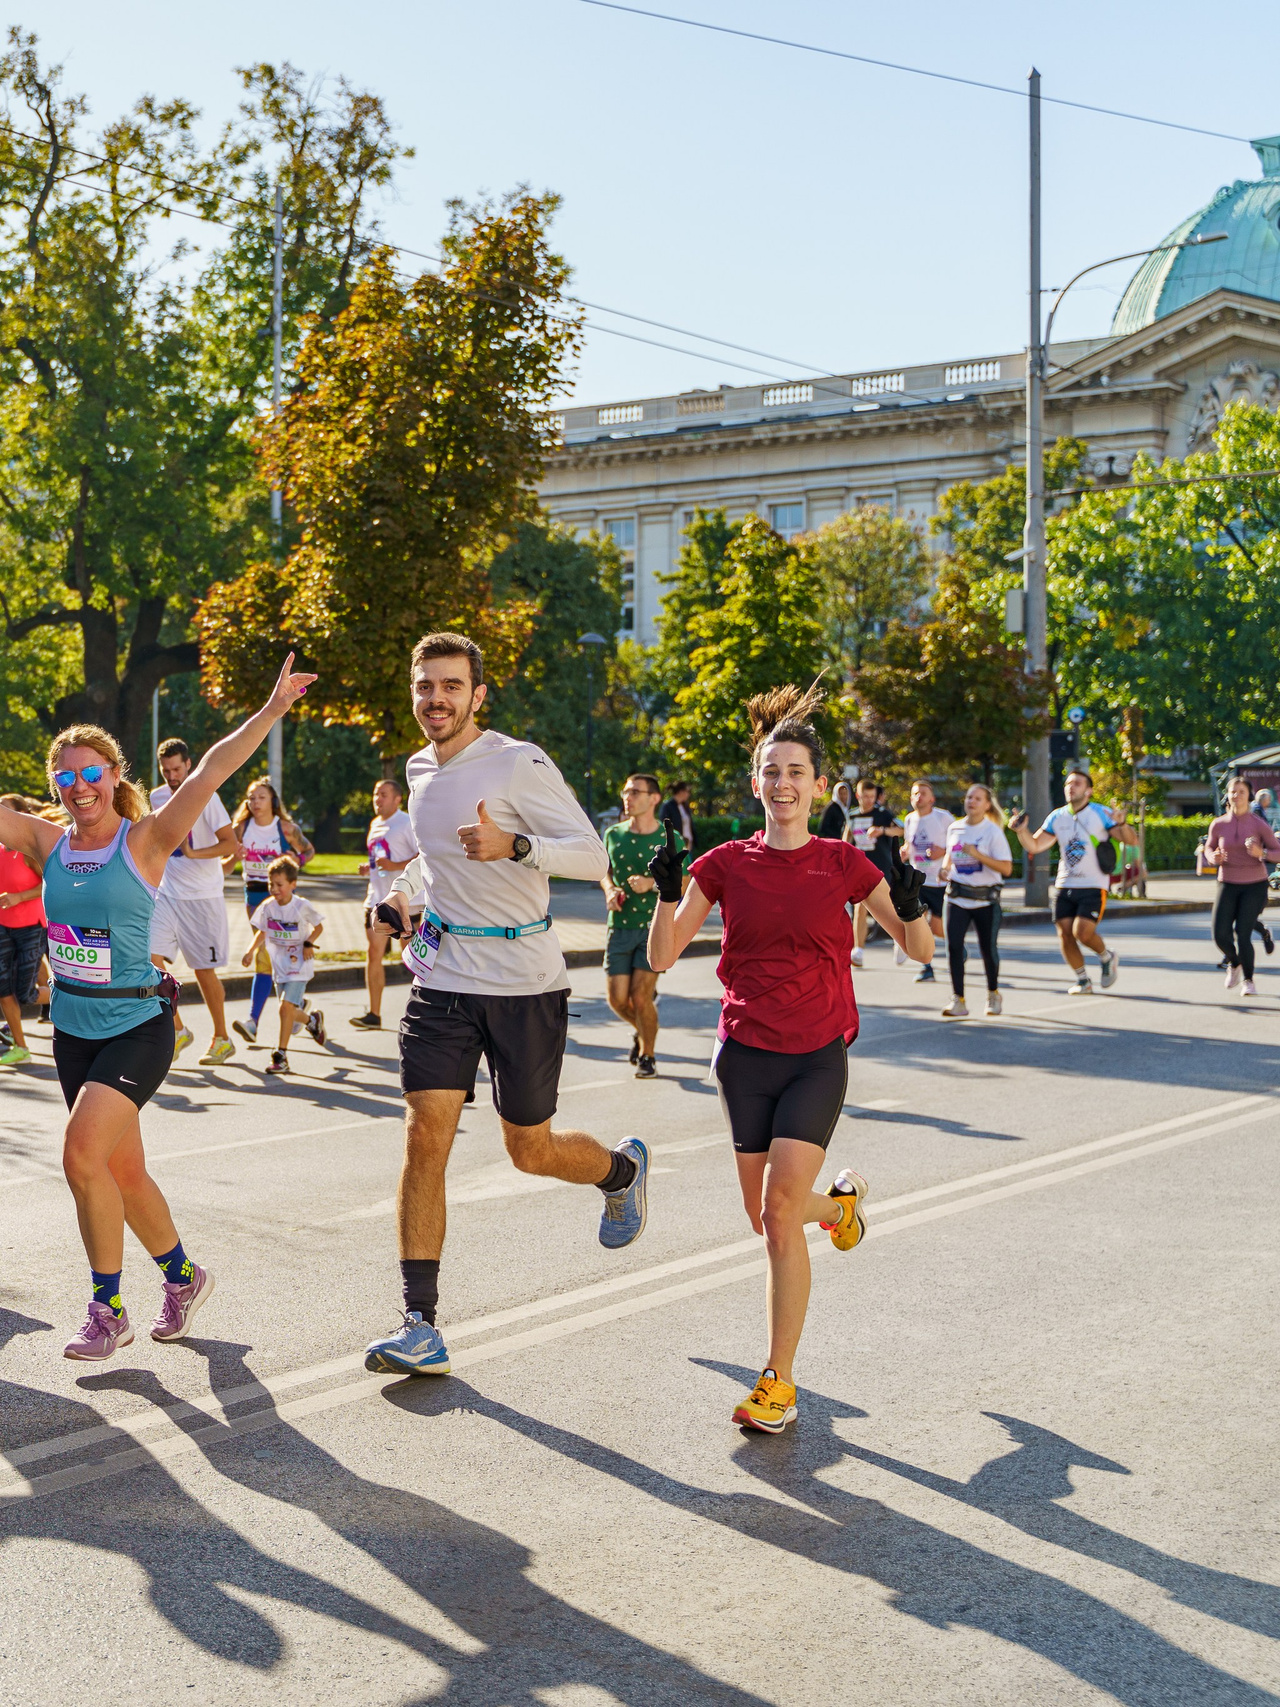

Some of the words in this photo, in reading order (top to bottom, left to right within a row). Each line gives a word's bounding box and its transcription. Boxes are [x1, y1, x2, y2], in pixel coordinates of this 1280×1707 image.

[274, 930, 292, 939] 3781
[451, 927, 485, 936] GARMIN
[56, 944, 98, 964] 4069
[209, 946, 218, 962] 1
